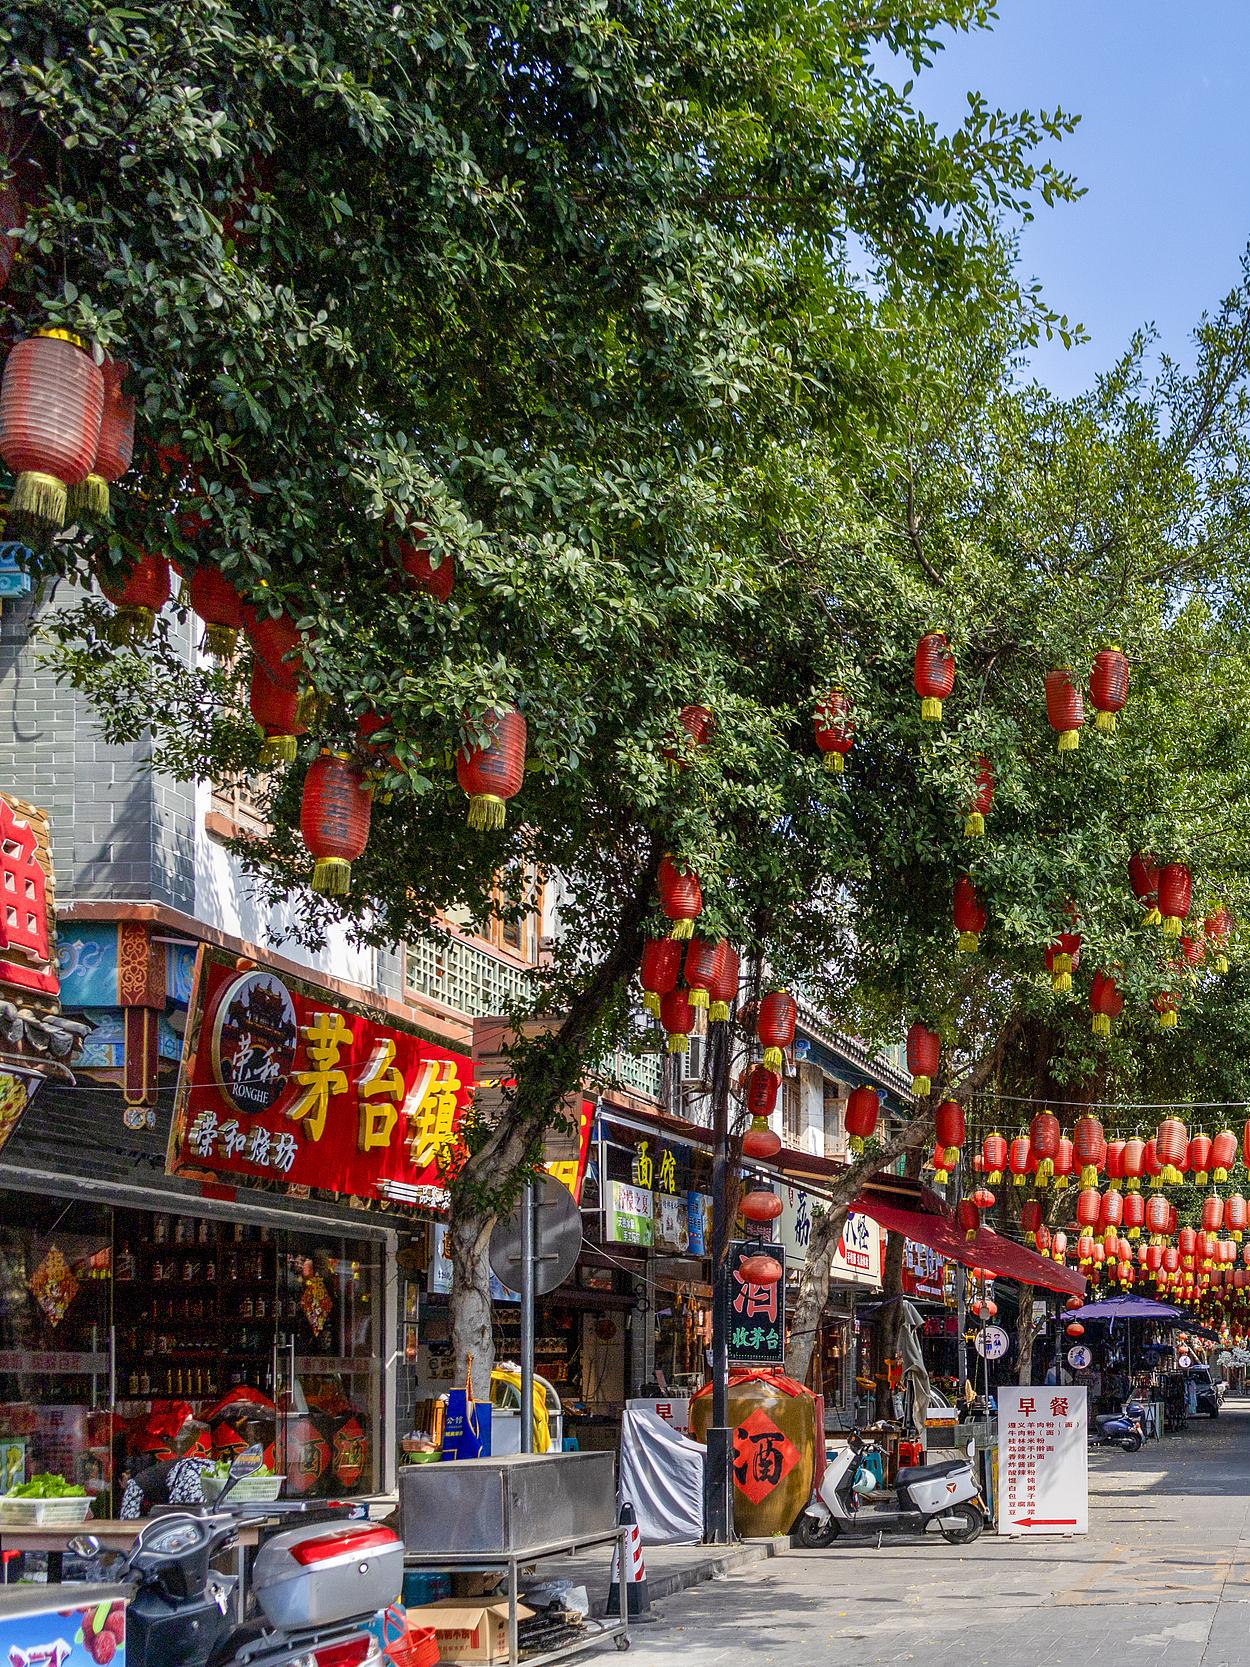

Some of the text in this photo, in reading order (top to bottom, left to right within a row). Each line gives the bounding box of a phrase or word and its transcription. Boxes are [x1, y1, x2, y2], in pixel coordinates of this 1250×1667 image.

[232, 1032, 281, 1084] 荣和
[232, 1082, 269, 1105] RONGHE
[286, 1012, 461, 1170] 茅台镇
[190, 1111, 299, 1173] 荣和烧坊
[634, 1141, 677, 1194] 面馆
[732, 1324, 780, 1351] 收茅台
[1017, 1396, 1069, 1418] 早餐
[734, 1430, 787, 1486] 酒
